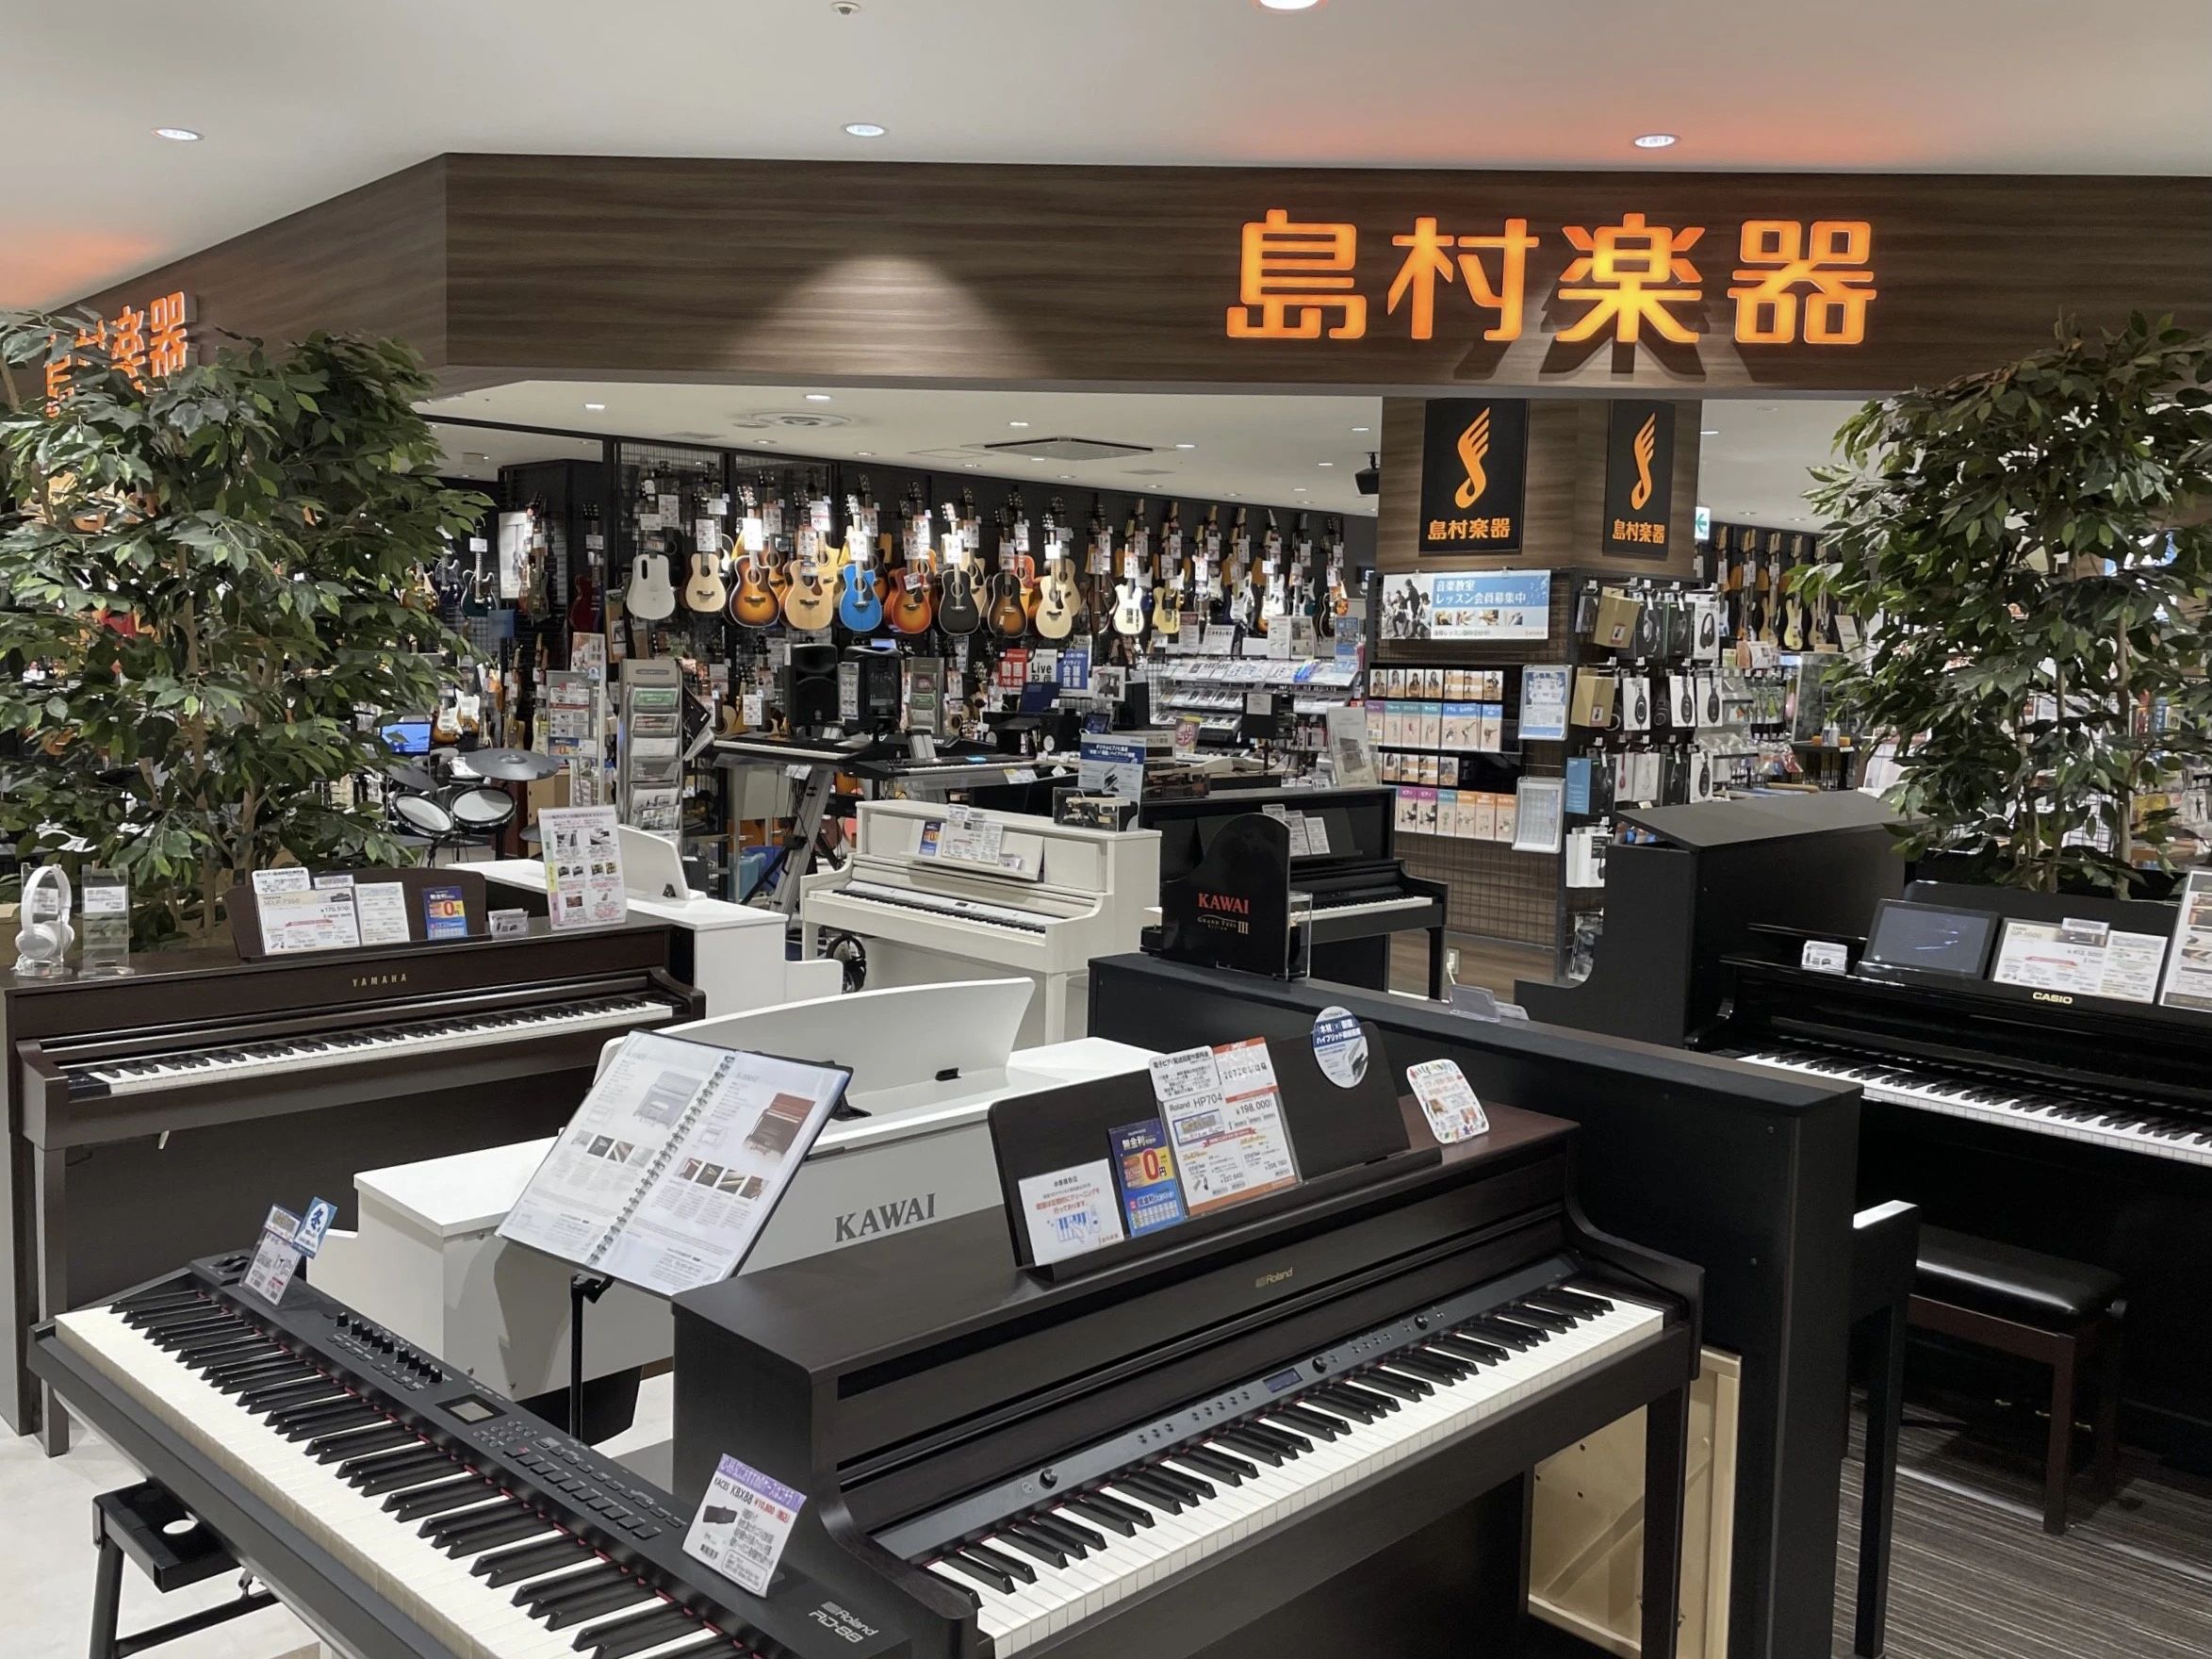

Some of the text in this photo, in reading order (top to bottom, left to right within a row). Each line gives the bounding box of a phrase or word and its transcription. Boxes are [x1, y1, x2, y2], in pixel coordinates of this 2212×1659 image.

[1226, 208, 1876, 345] 島村楽器
[1427, 517, 1511, 542] 島村楽器
[1612, 518, 1666, 544] 島村楽器
[1436, 579, 1476, 592] 音楽教室
[1435, 592, 1527, 605] レッスン会員募集中
[1031, 663, 1052, 674] Live
[1198, 893, 1250, 914] KAWAI
[352, 973, 408, 988] YAMAHA
[2032, 991, 2073, 1005] CASIO
[1193, 1092, 1223, 1109] HP704
[835, 1192, 936, 1243] KAWAI
[1266, 1267, 1294, 1285] Roland
[808, 1609, 864, 1643] RD-88
[835, 1610, 879, 1636] Roland
